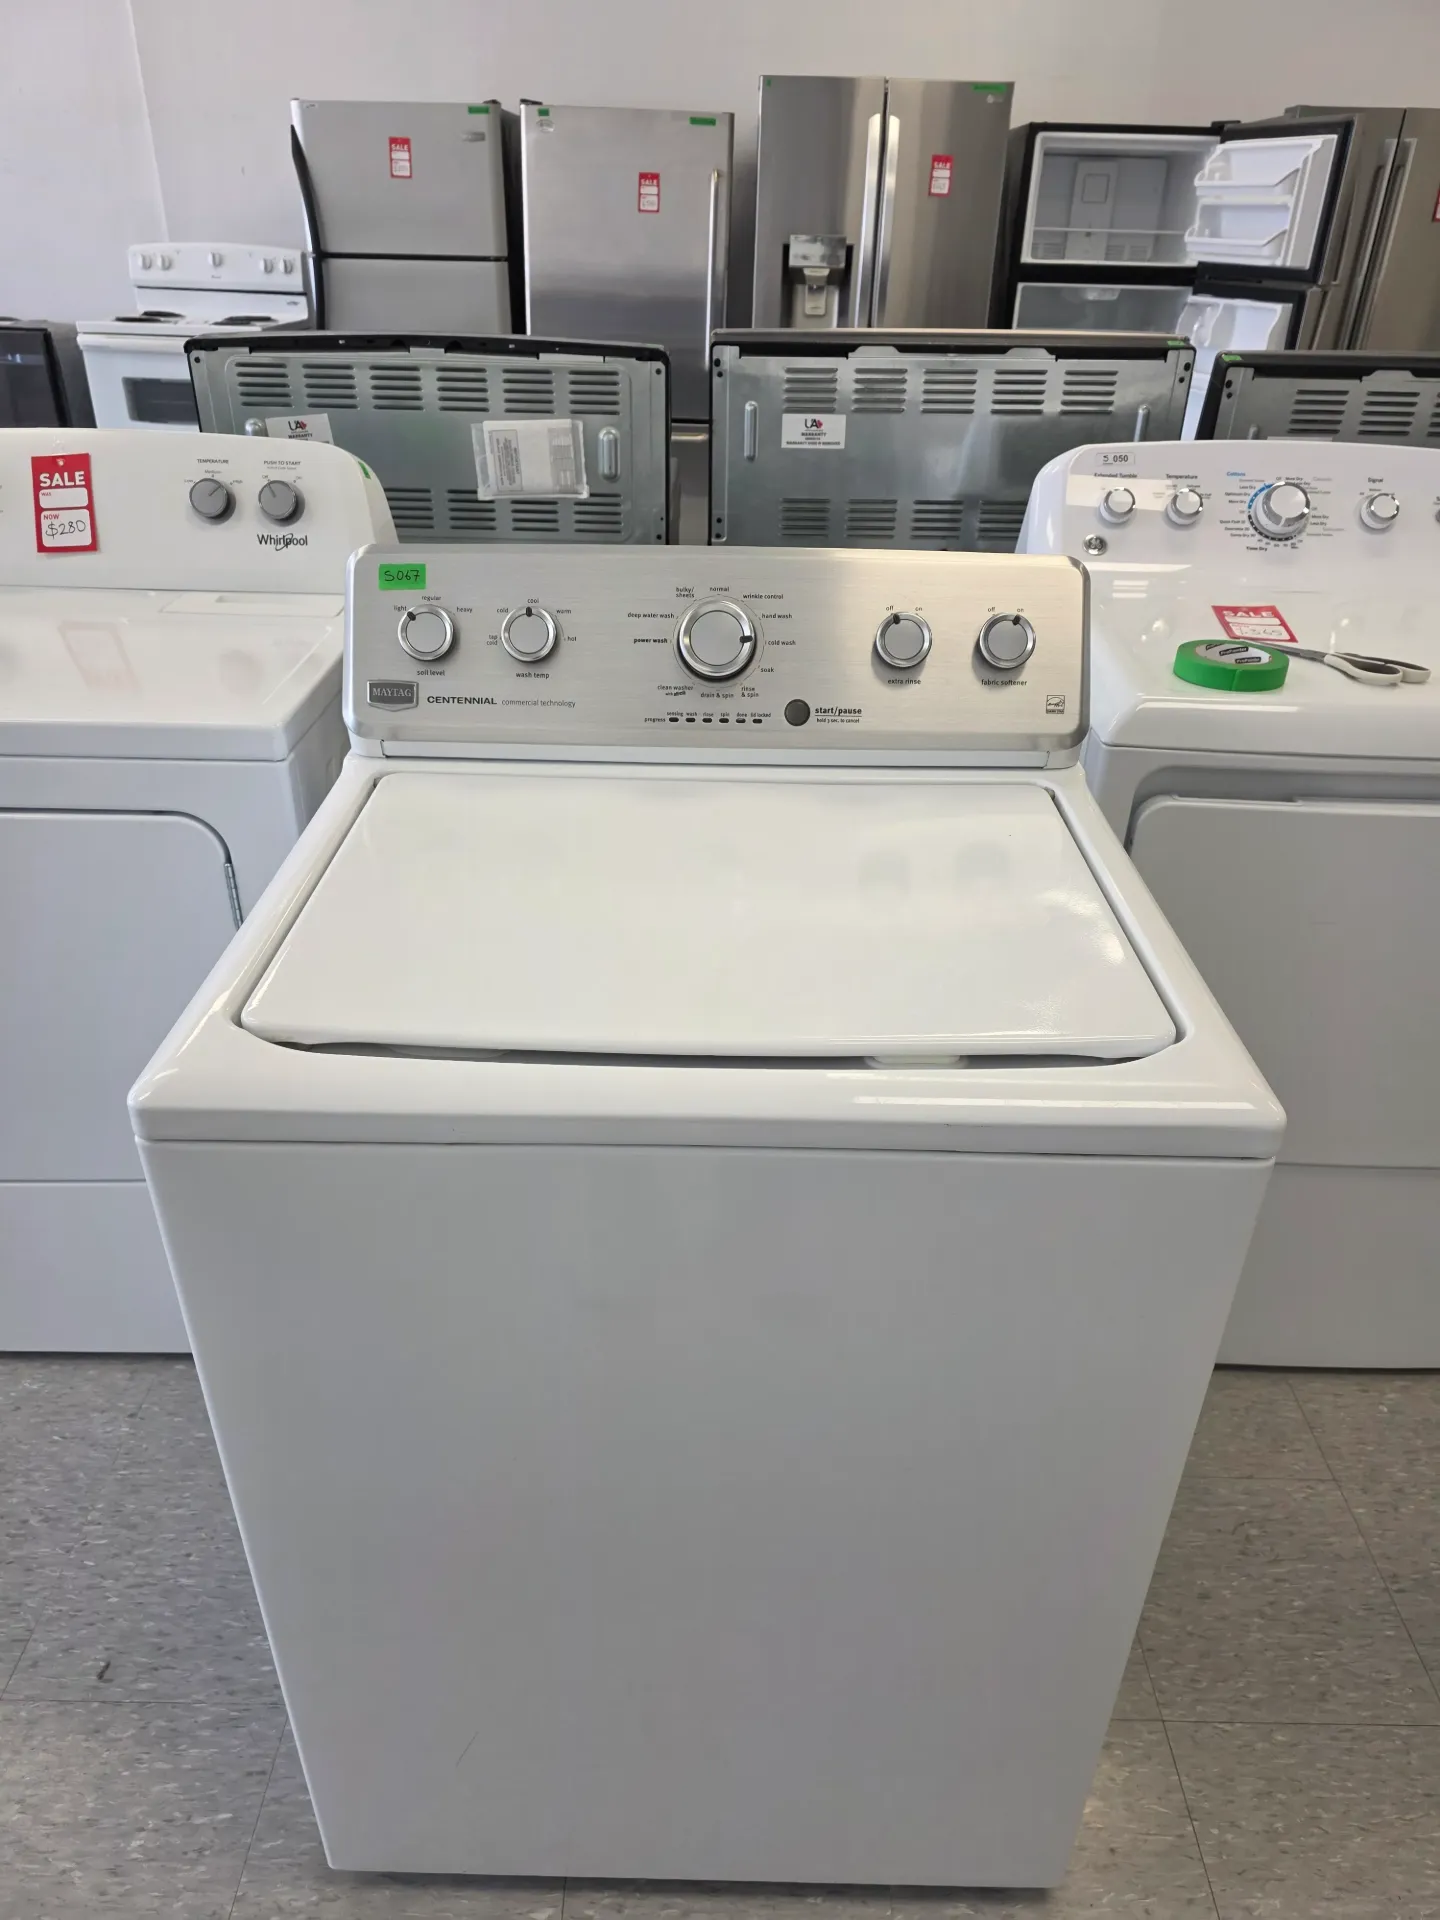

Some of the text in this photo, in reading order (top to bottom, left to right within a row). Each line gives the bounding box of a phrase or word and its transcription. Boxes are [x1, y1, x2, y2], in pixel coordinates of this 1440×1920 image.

[39, 471, 85, 487] SALE
[46, 520, 86, 539] $280
[257, 533, 308, 551] Whirlpool
[372, 687, 412, 697] MAYTAG
[427, 696, 497, 705] CENTENNIAL
[540, 699, 575, 708] technology
[815, 706, 862, 716] start/pause
